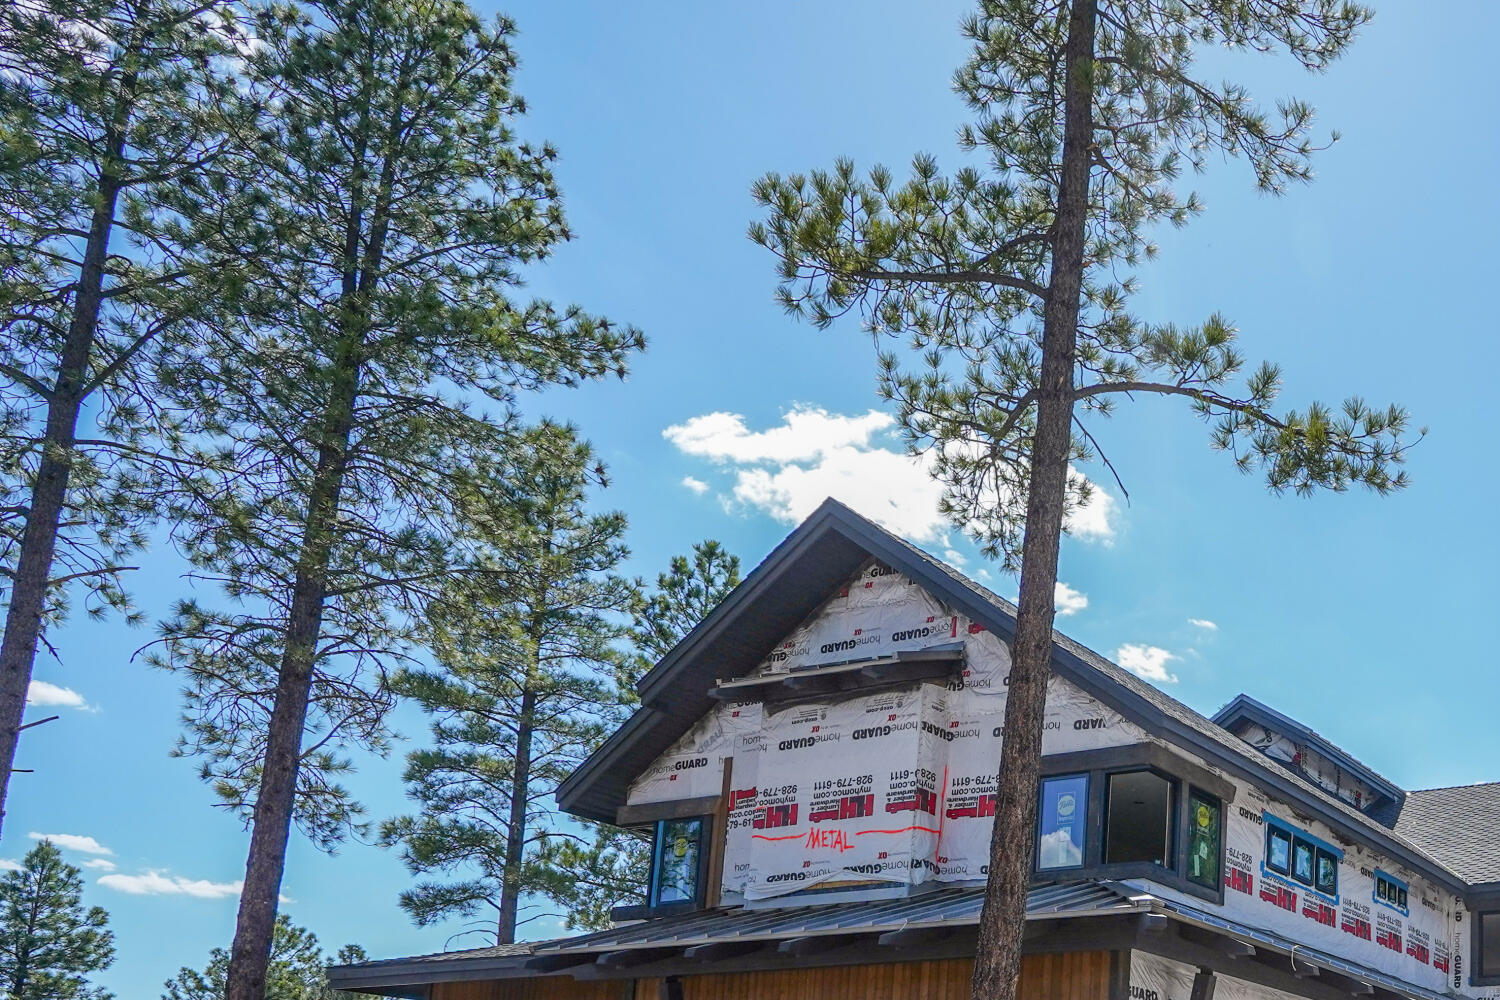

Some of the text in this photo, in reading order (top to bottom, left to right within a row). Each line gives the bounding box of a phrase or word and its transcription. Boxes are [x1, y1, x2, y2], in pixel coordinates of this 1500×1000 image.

[820, 634, 881, 655] homeGUARD
[946, 677, 992, 692] homeGU
[852, 720, 918, 741] homeGUARD
[779, 731, 841, 751] homeGUARD
[652, 757, 709, 774] homeGUARD
[814, 774, 873, 791] 928-779-6111
[813, 786, 872, 800] myhomco.com
[809, 797, 841, 807] Hardware
[816, 803, 840, 812] Lumber
[805, 827, 855, 853] METAL
[843, 859, 910, 875] homeGUAR
[1454, 932, 1462, 989] homeGUARD
